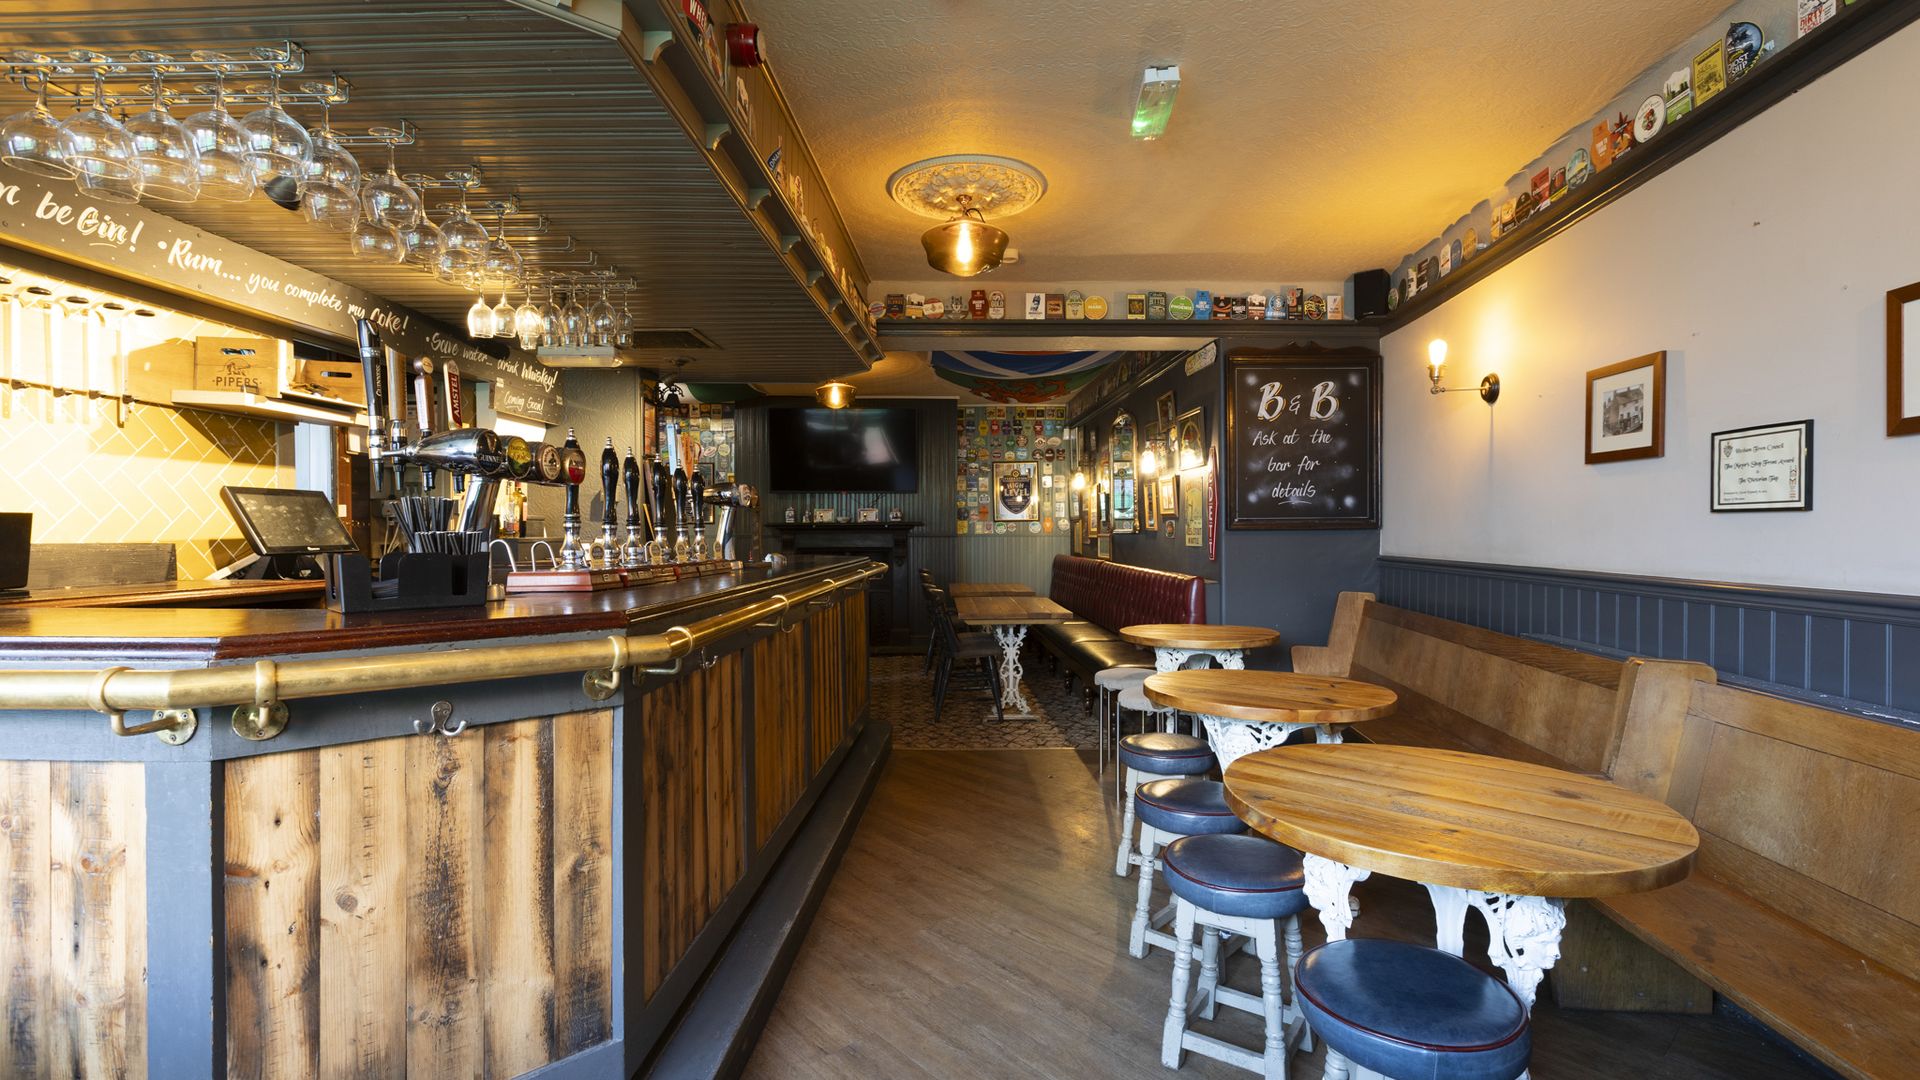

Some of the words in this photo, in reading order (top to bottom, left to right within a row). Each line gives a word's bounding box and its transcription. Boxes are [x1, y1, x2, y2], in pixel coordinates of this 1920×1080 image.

[35, 191, 74, 225] be
[77, 206, 144, 253] Gin!
[245, 273, 279, 294] you
[284, 283, 343, 312] complete
[348, 303, 365, 324] my
[431, 332, 459, 356] Save
[215, 376, 259, 387] PIPERS
[450, 374, 460, 417] AMSTEL
[504, 391, 525, 411] Coming
[1257, 381, 1287, 422] B
[1289, 395, 1301, 415] &
[1309, 381, 1339, 422] B
[1252, 431, 1278, 446] Ask
[1283, 429, 1300, 445] at
[1309, 429, 1333, 444] the
[1267, 457, 1291, 472] bar
[1297, 456, 1320, 475] for
[1004, 488, 1030, 497] LEVEL
[1272, 480, 1316, 499] details
